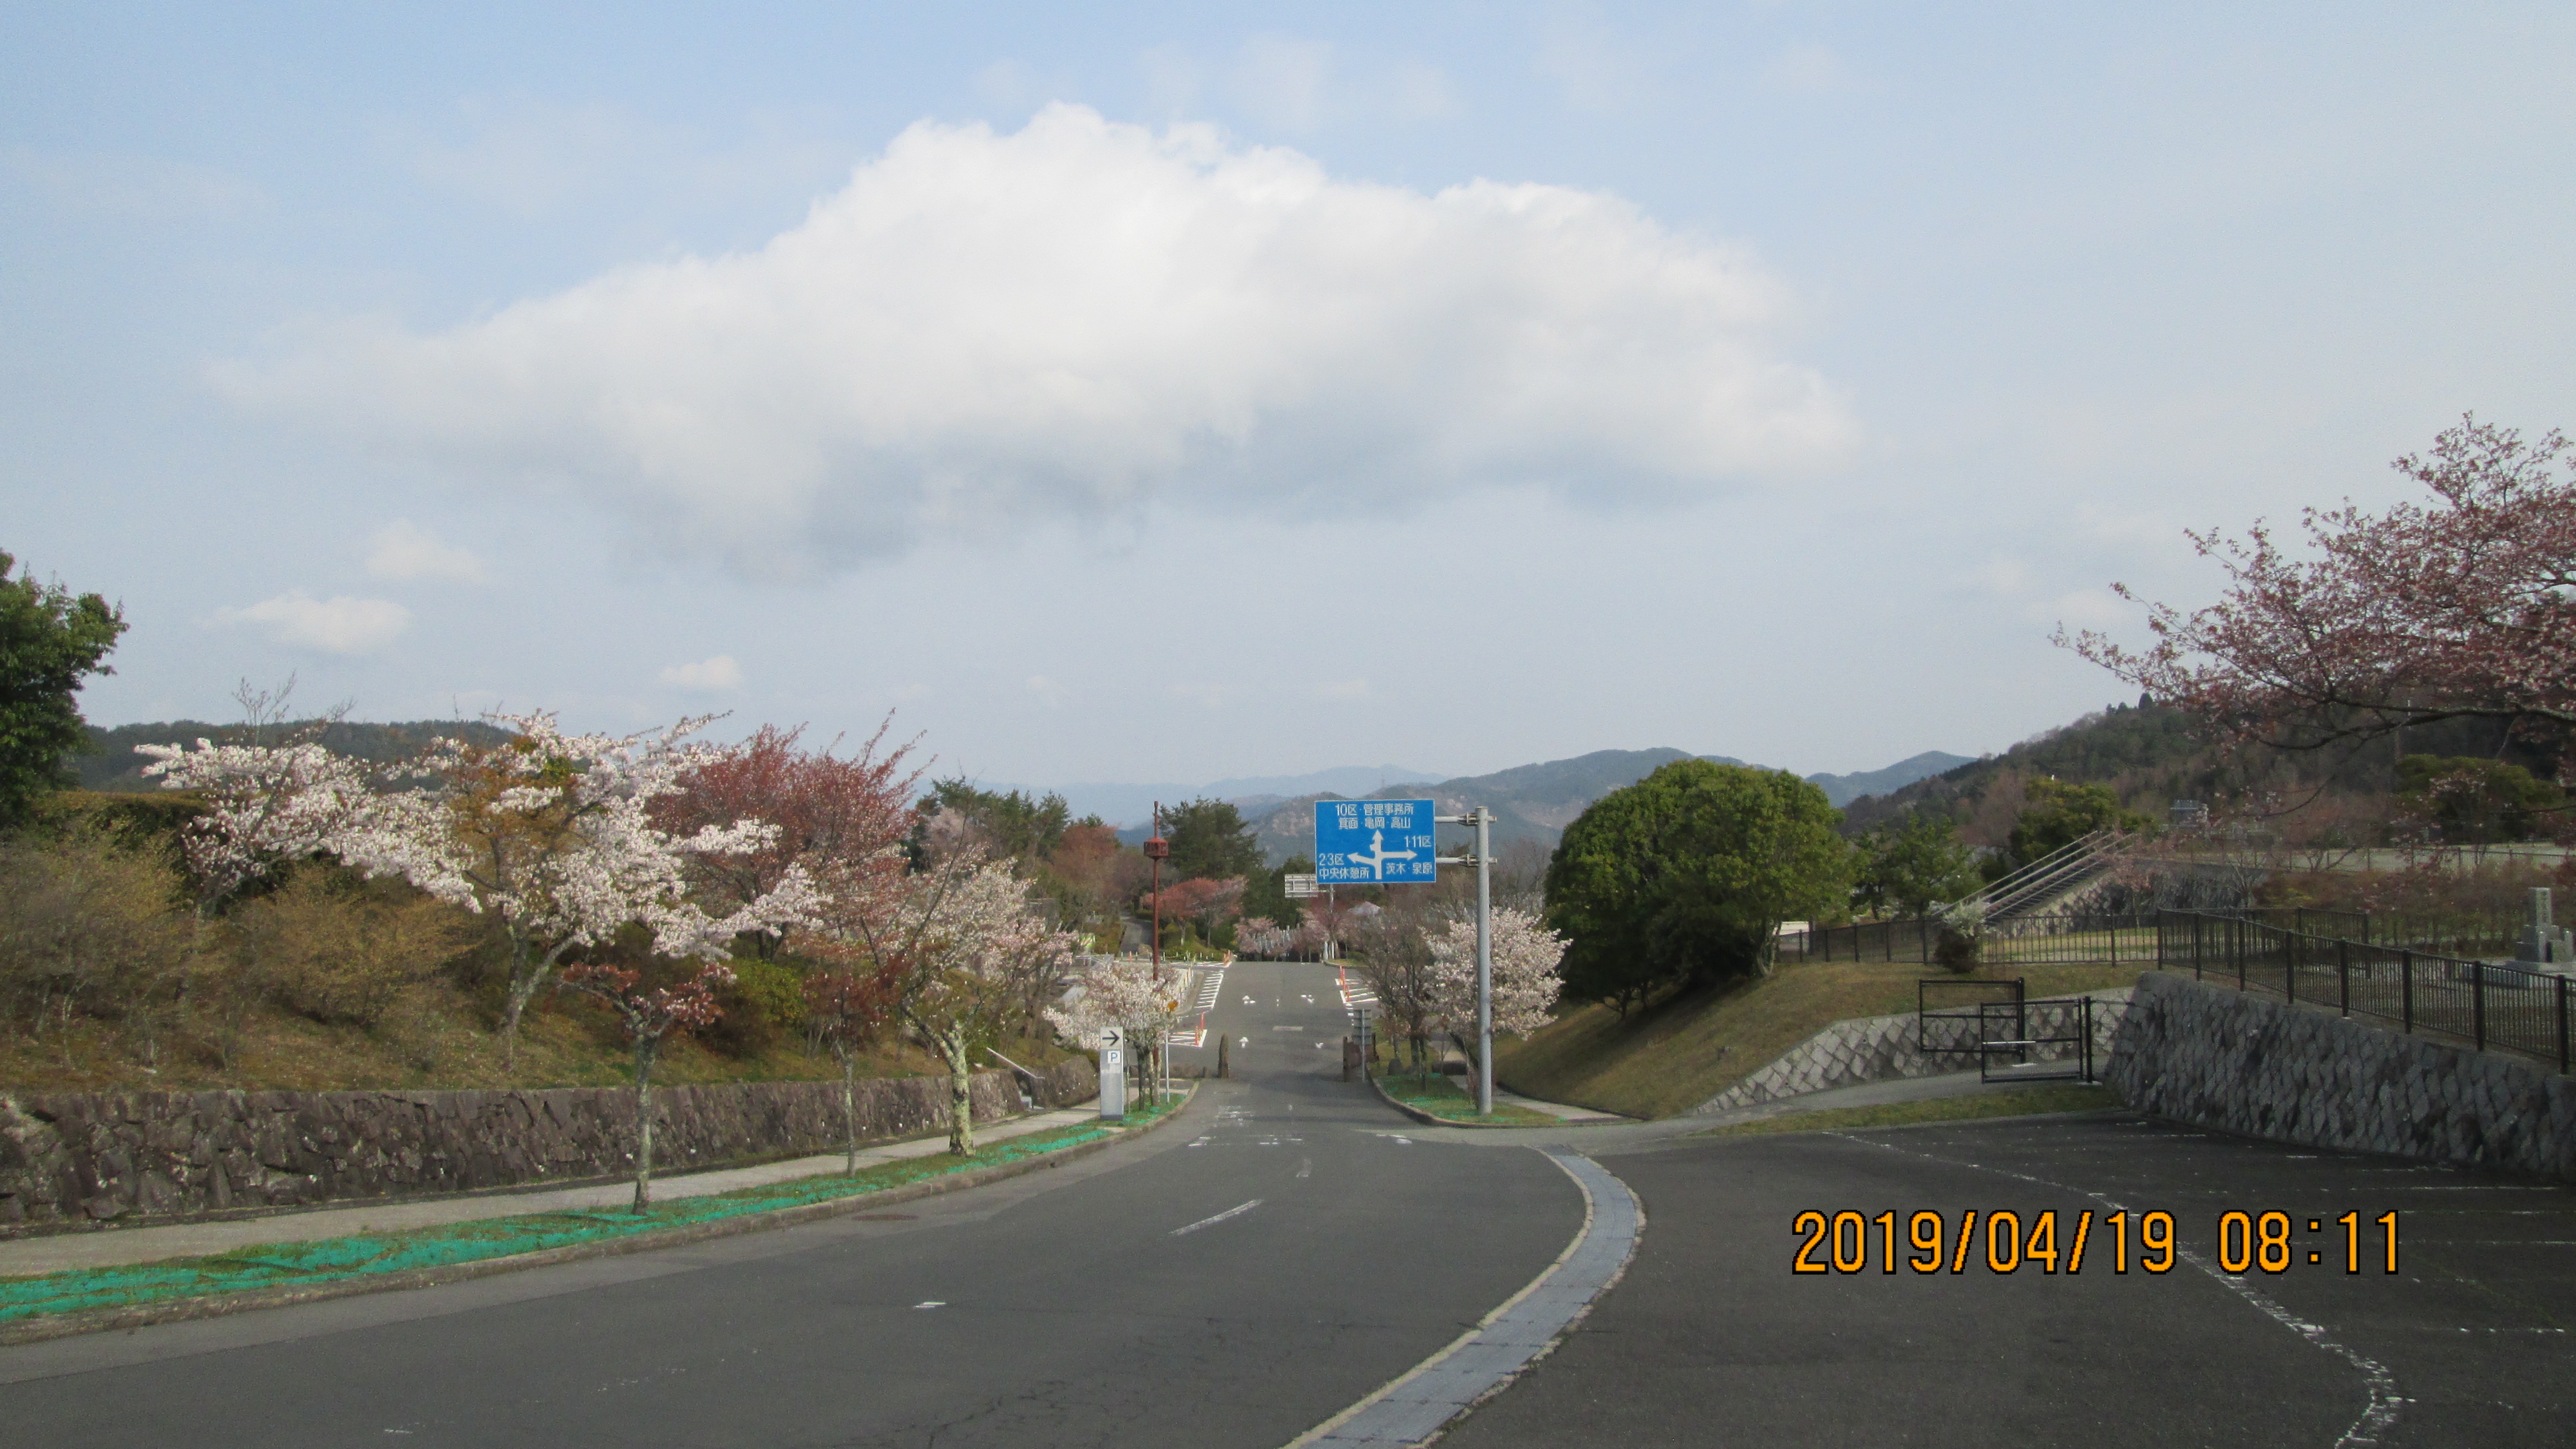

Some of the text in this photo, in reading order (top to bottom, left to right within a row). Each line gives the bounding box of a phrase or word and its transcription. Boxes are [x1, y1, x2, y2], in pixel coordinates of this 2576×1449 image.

[1319, 867, 1369, 880] 中央休憩所
[1111, 1052, 1118, 1062] P
